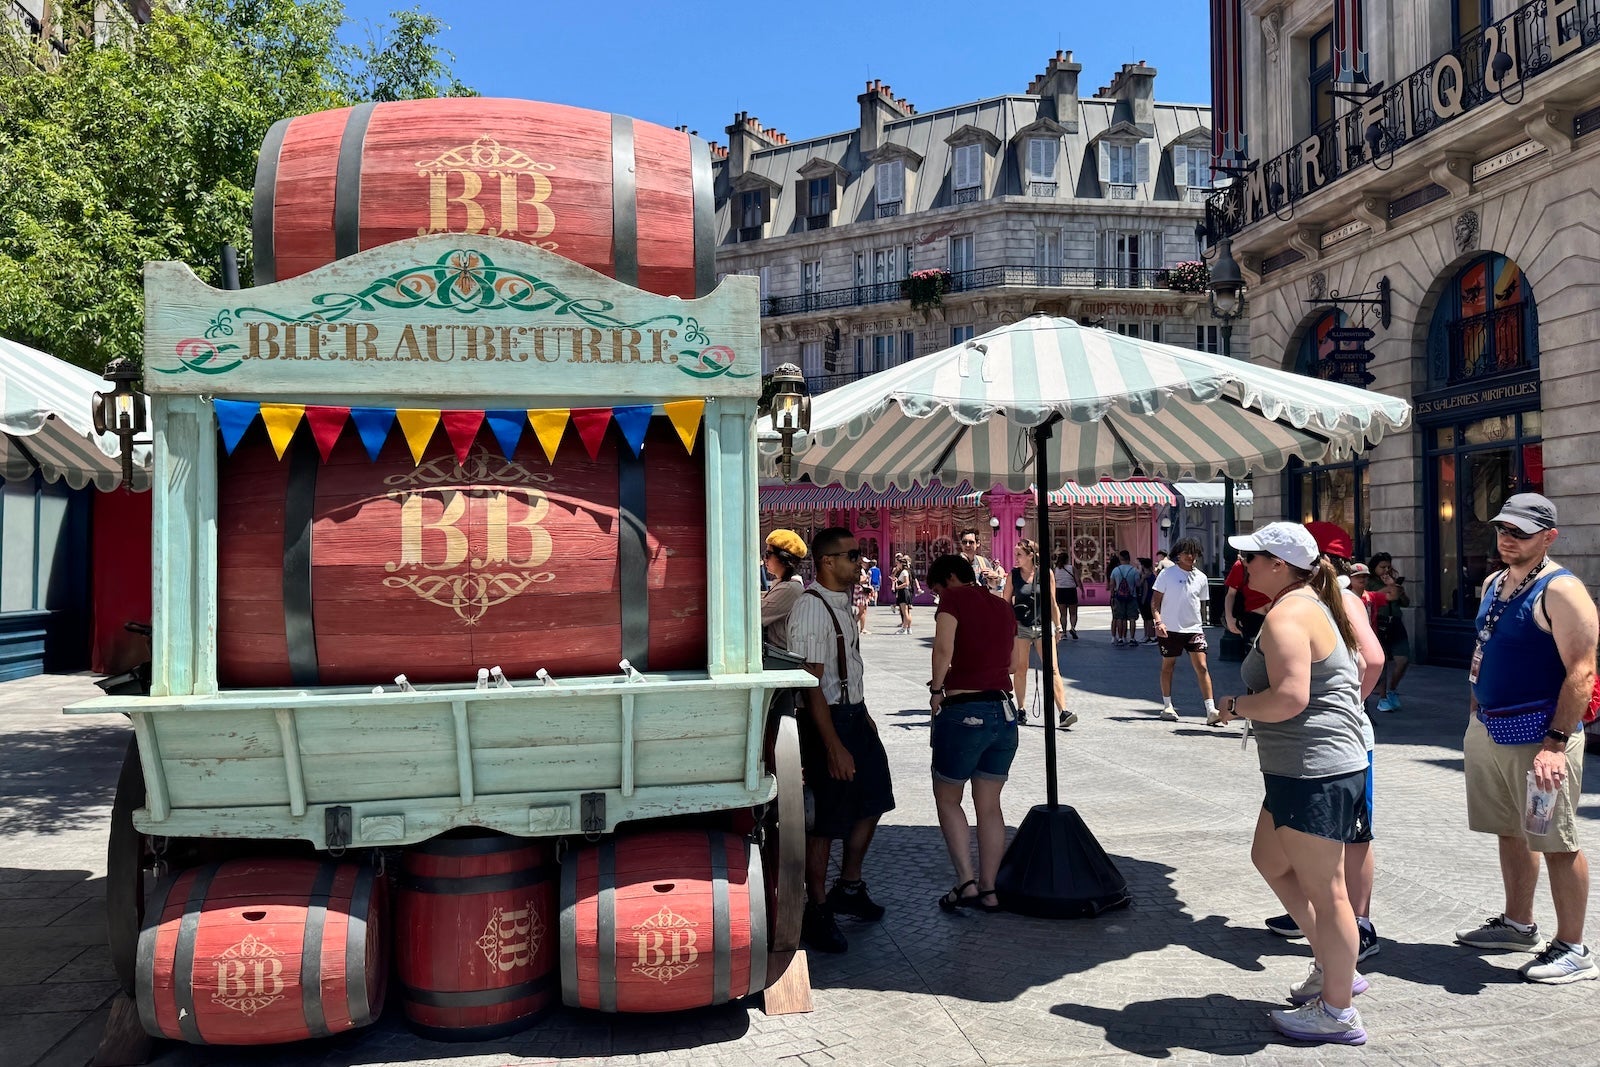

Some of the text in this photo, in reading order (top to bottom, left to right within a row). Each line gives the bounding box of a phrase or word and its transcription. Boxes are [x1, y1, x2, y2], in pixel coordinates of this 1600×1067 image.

[417, 169, 555, 239] BB
[1413, 381, 1537, 414] LES GALERIES MIRIFIQUES
[384, 488, 553, 572] BB
[498, 906, 529, 972] BB
[631, 927, 699, 968] BB
[211, 957, 284, 998] BB
